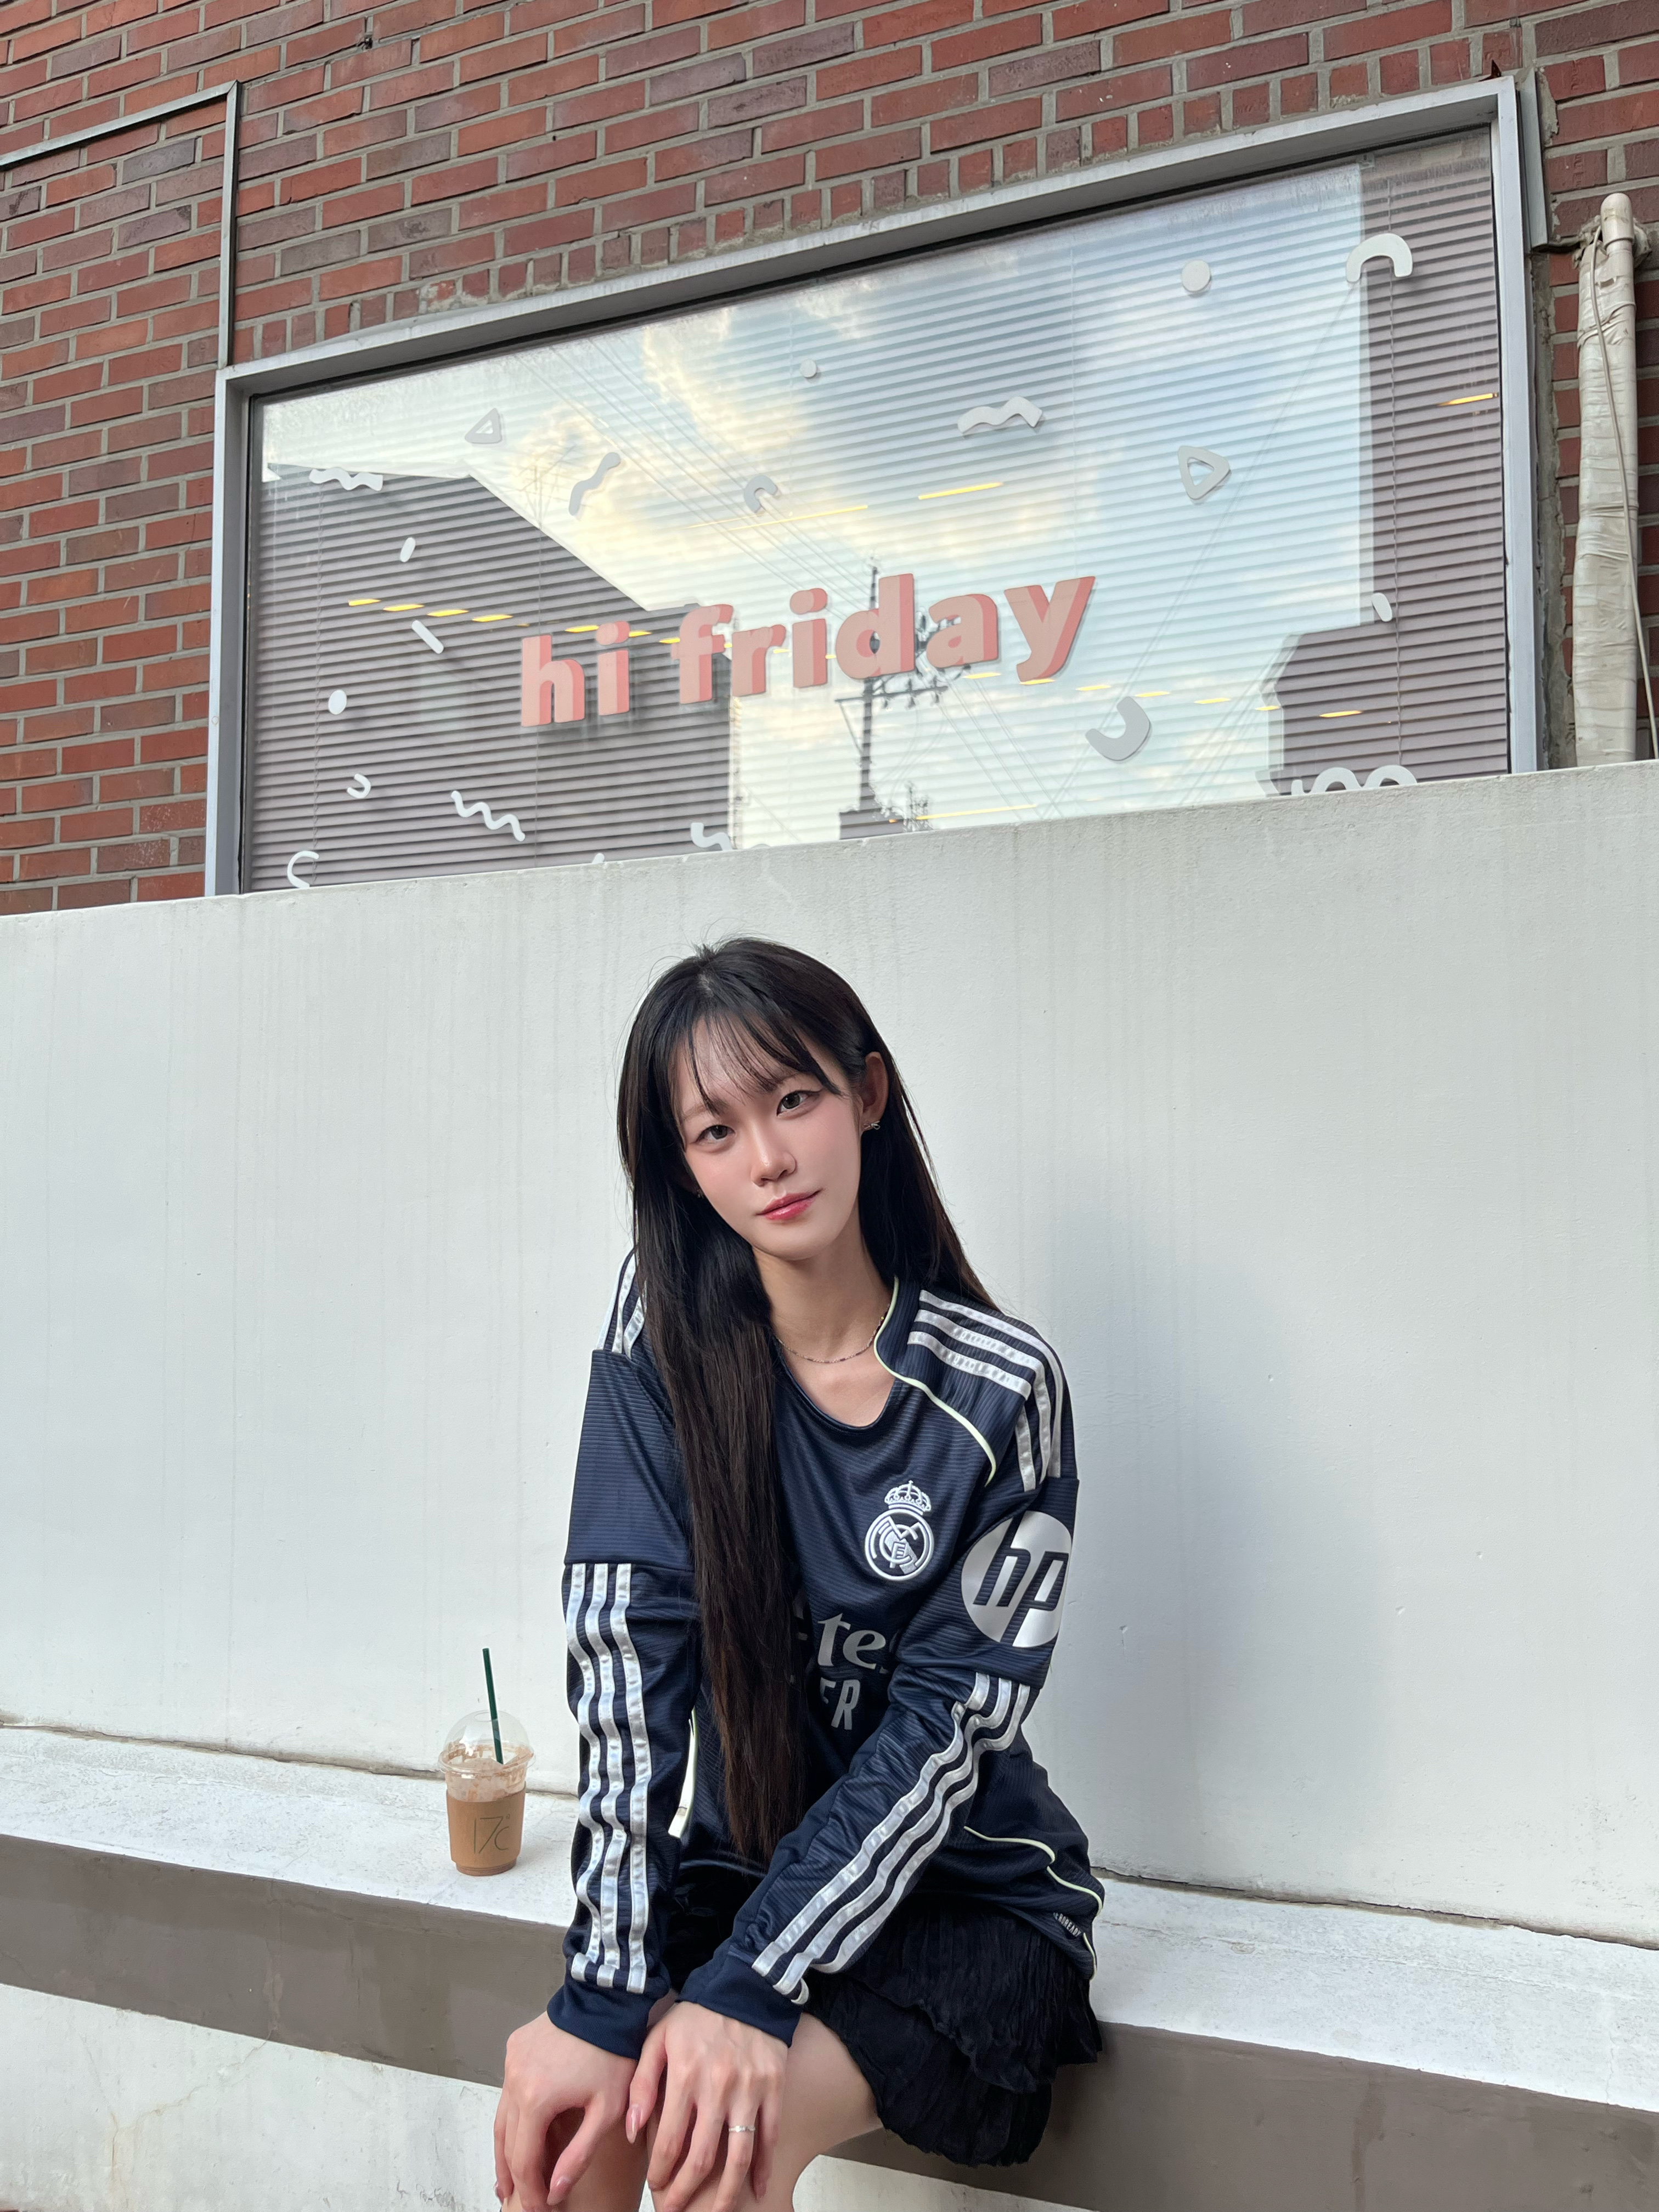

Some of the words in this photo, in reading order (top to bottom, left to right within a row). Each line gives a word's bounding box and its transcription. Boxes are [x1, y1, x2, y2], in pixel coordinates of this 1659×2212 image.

[521, 620, 630, 727] hi
[673, 573, 1096, 704] friday
[972, 1510, 1070, 1647] hp
